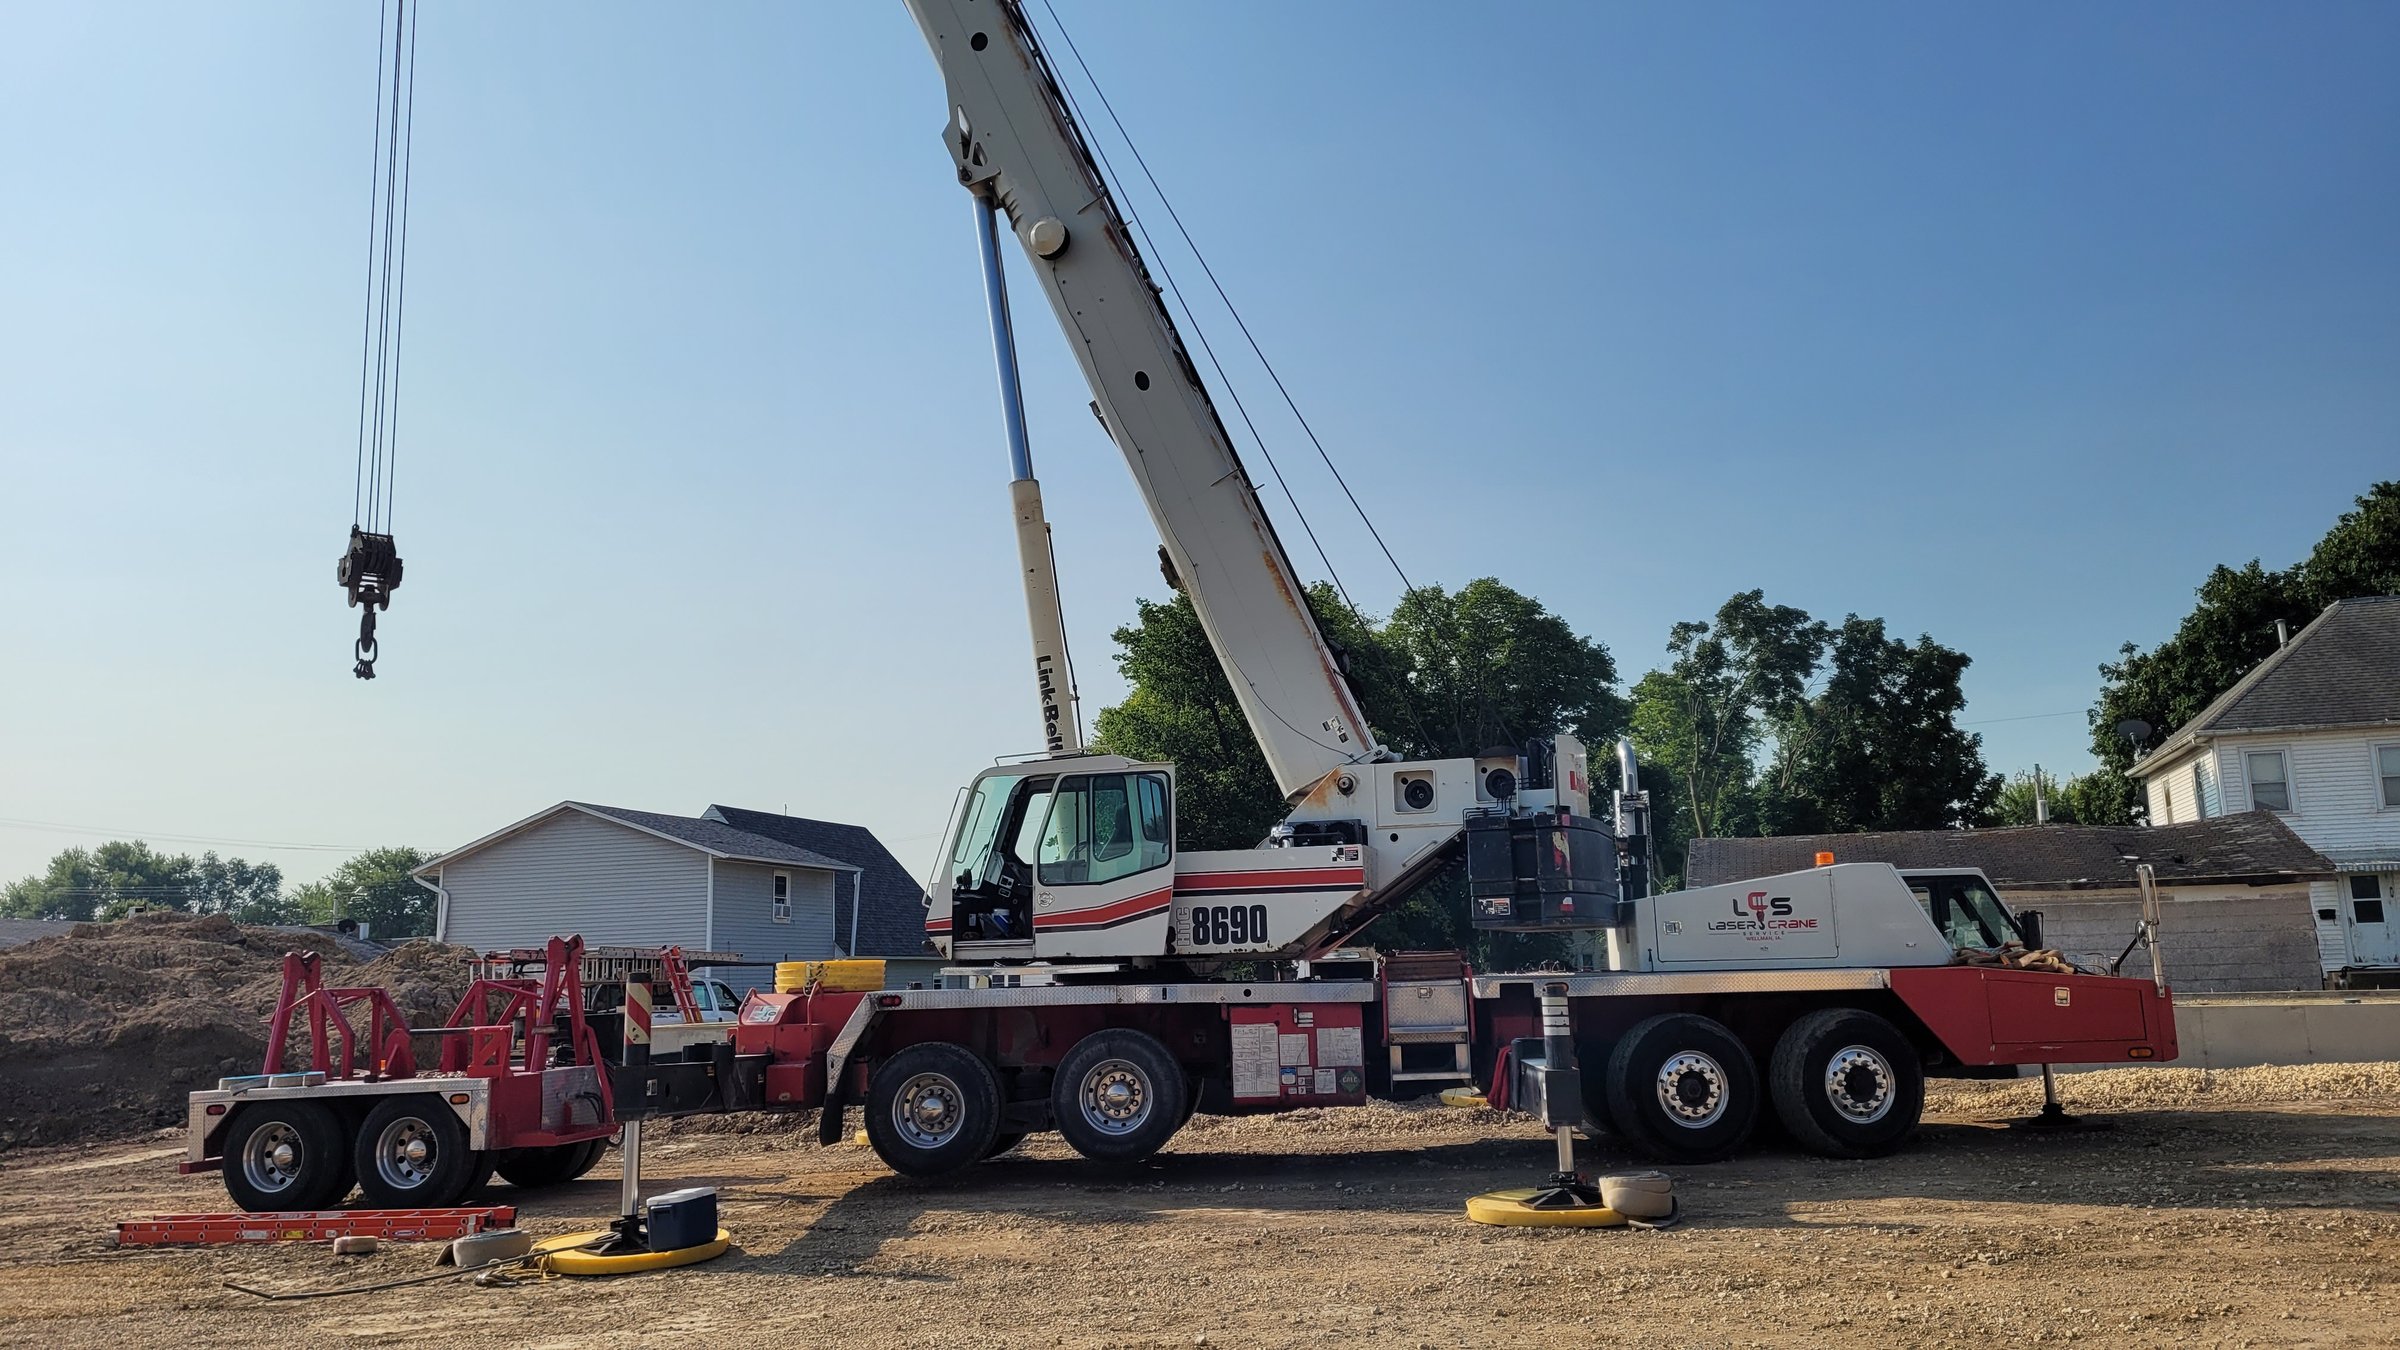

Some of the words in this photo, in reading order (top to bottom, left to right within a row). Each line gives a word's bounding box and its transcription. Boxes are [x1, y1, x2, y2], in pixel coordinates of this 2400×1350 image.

[1036, 655, 1063, 751] Link-Belt
[1176, 907, 1190, 946] HTC
[1192, 905, 1267, 945] 8690
